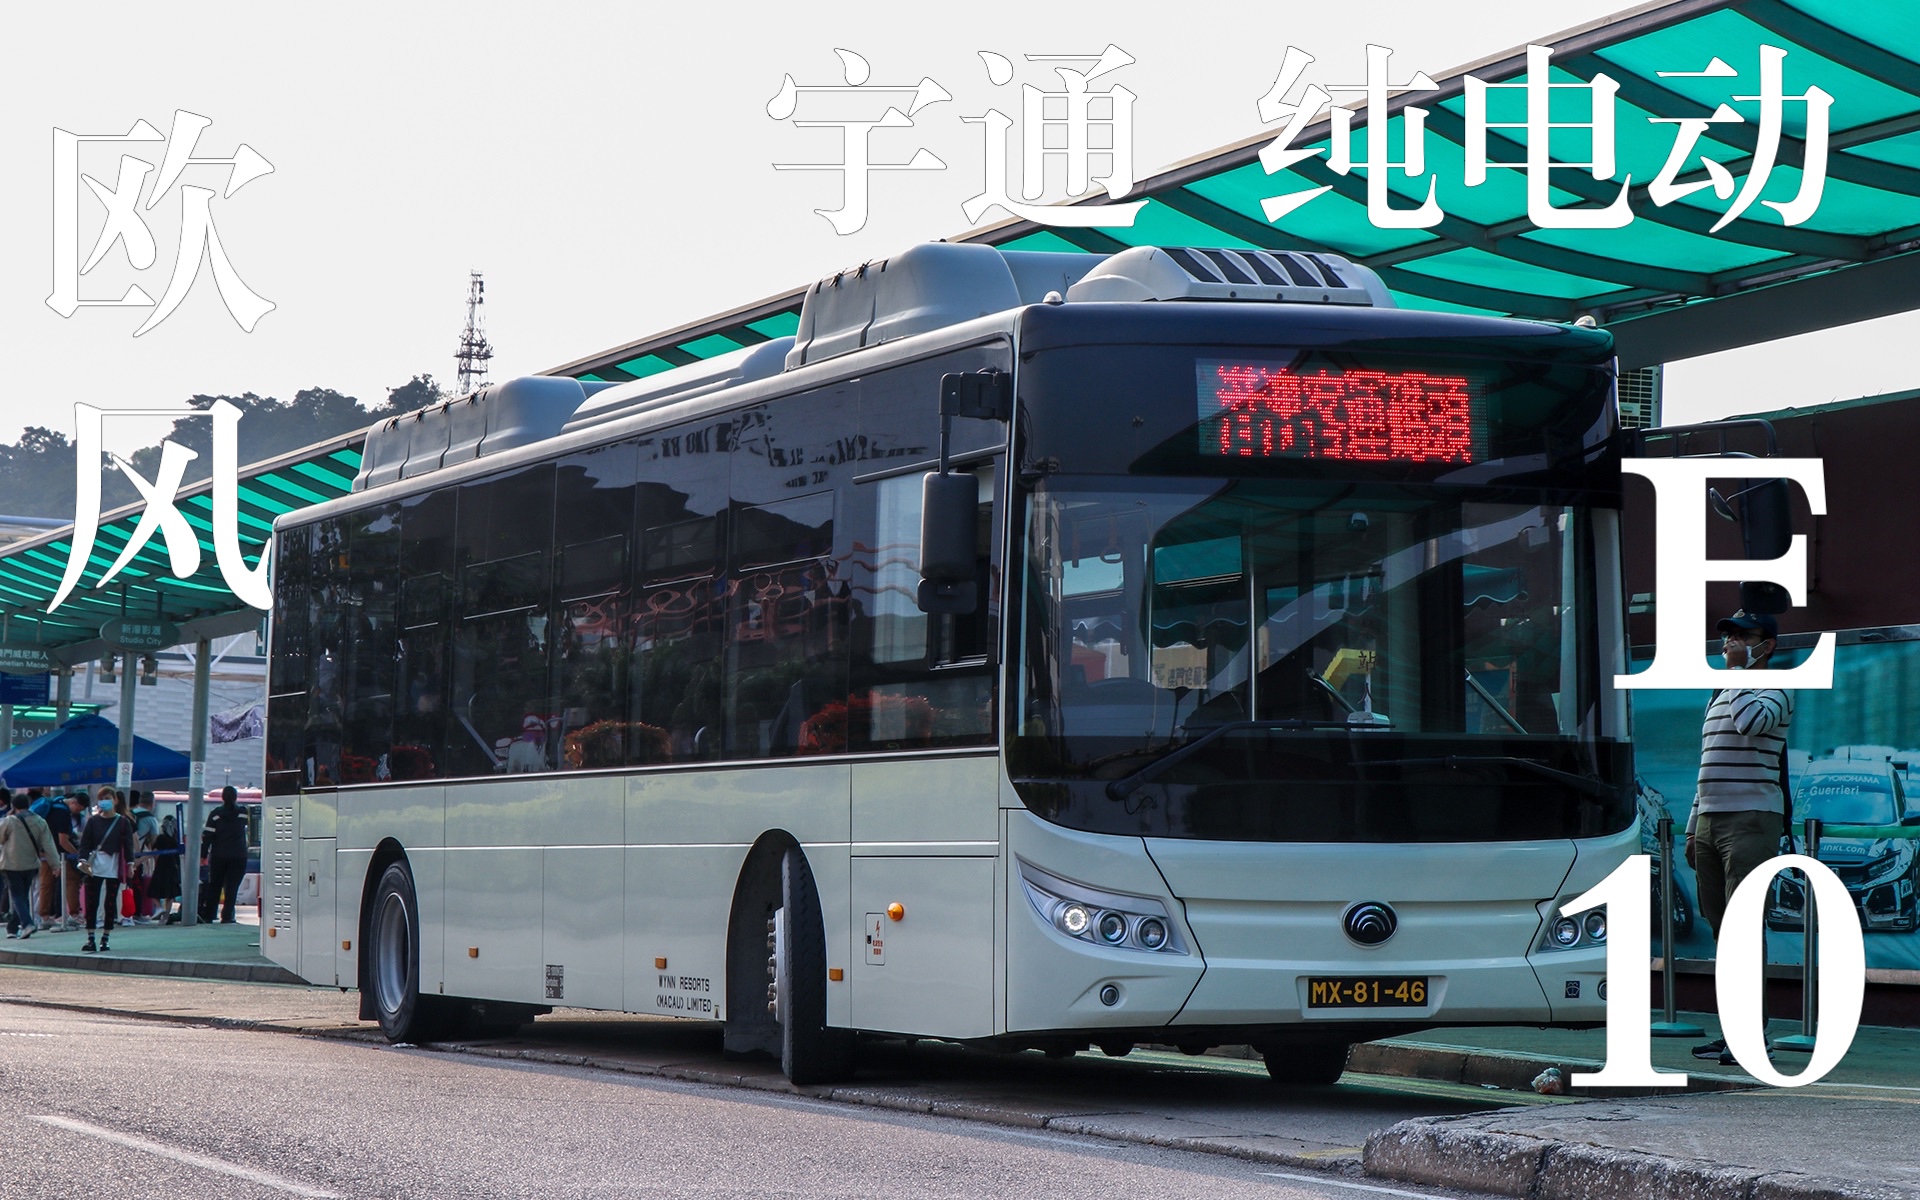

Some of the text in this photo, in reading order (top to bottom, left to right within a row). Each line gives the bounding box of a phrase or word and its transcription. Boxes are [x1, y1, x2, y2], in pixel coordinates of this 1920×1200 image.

[120, 635, 162, 646] Studio City
[26, 660, 49, 669] Macao
[22, 727, 34, 738] to
[1827, 774, 1880, 784] YOKOHAMA
[1797, 785, 1860, 799] E. Guerrieri
[658, 974, 710, 992] WYNN RESORTS
[1312, 981, 1425, 1004] MX-81-46
[656, 994, 712, 1013] (MACAU) LIMITED
